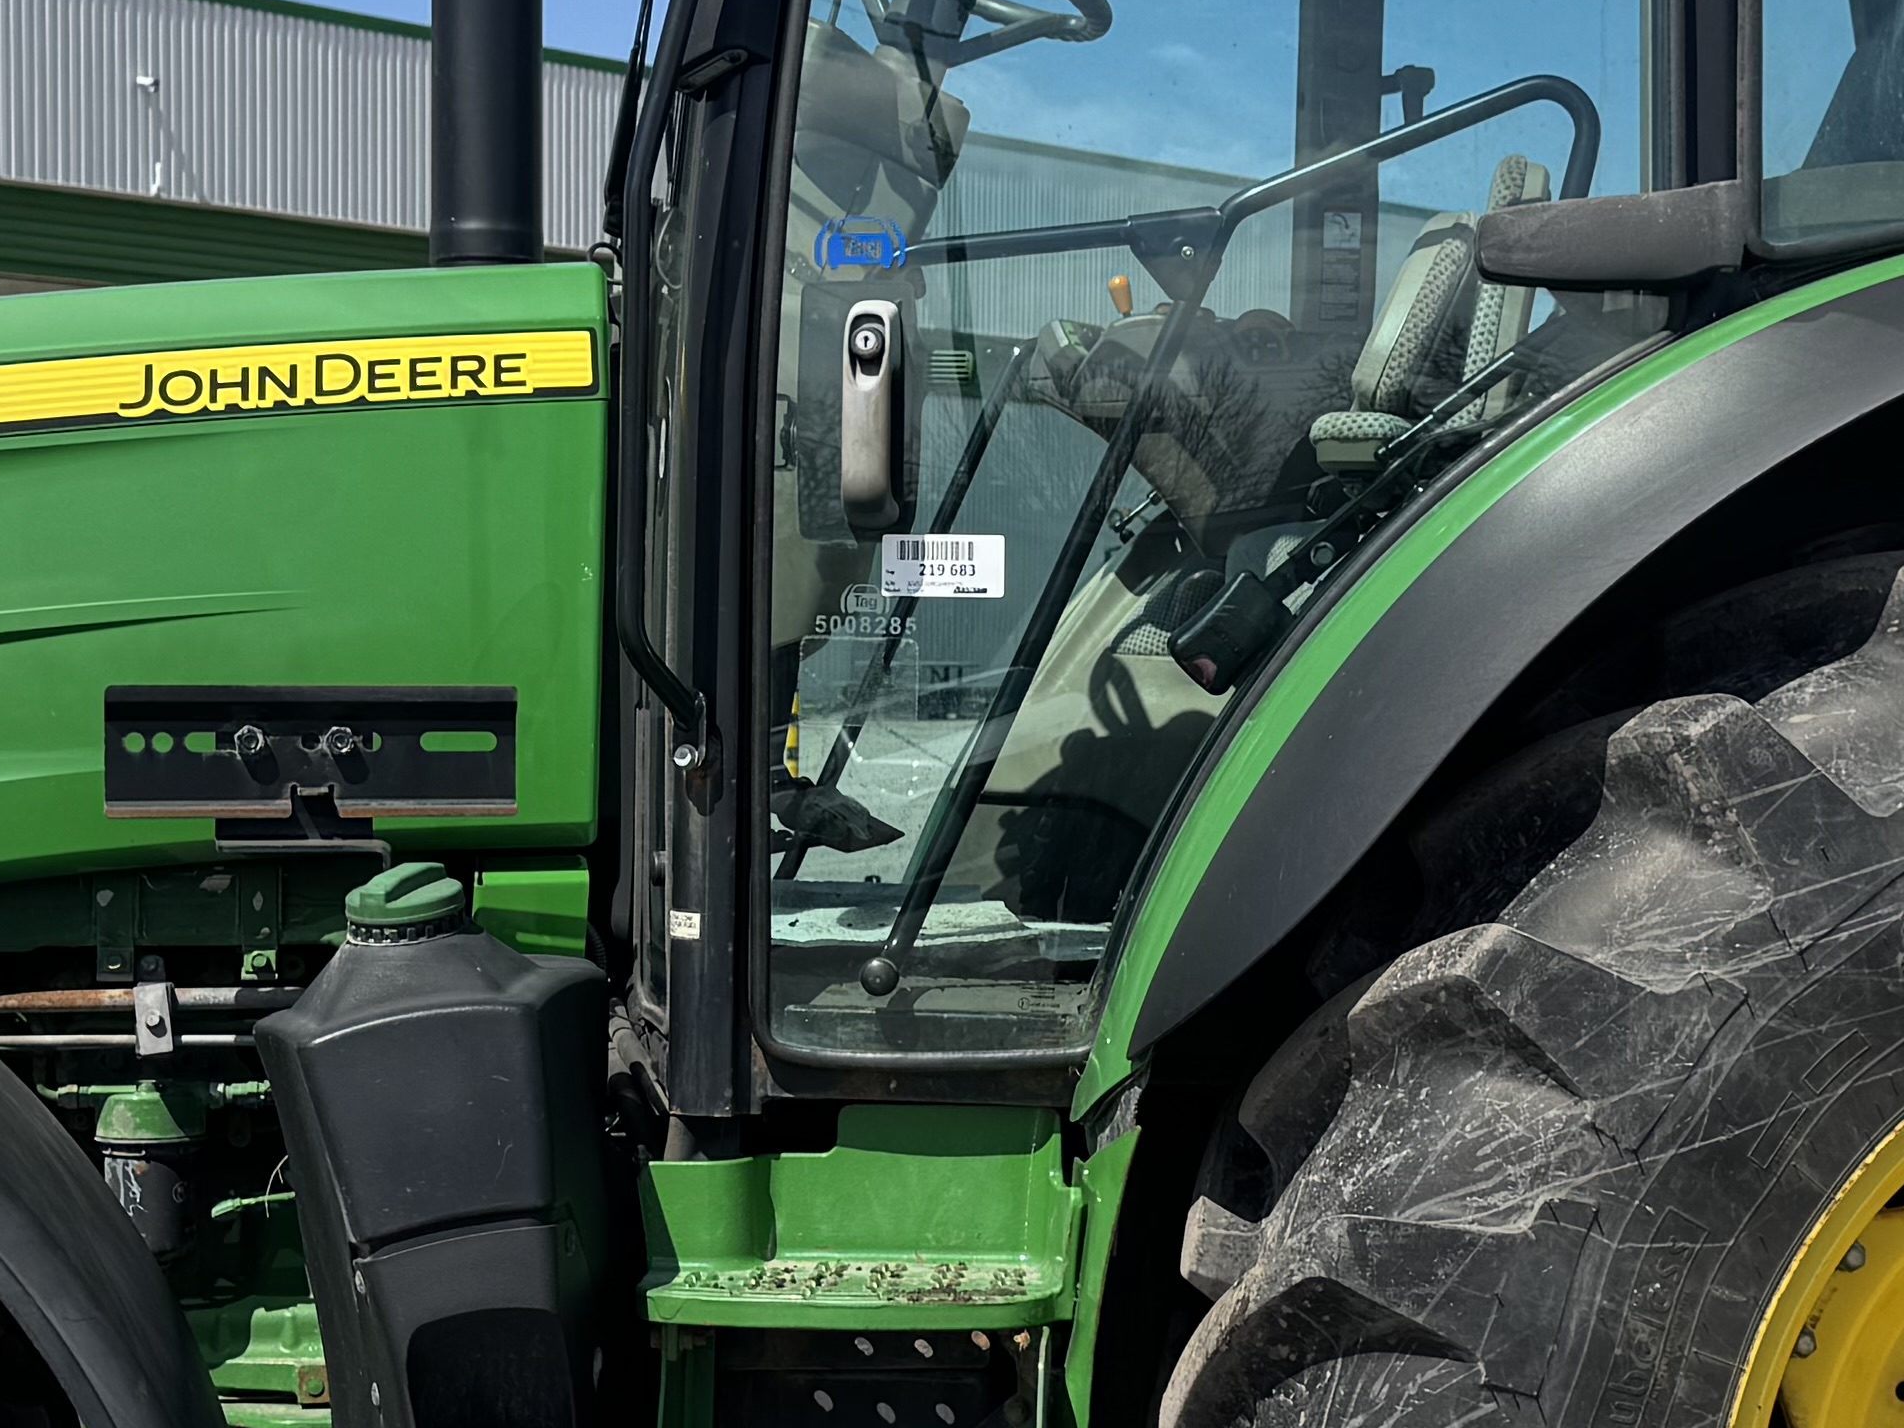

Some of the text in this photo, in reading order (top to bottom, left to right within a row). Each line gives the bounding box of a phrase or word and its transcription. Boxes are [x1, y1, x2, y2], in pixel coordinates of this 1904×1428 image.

[120, 353, 527, 410] JOHN DEERE
[854, 595, 877, 609] Tag
[814, 614, 916, 635] 5008285
